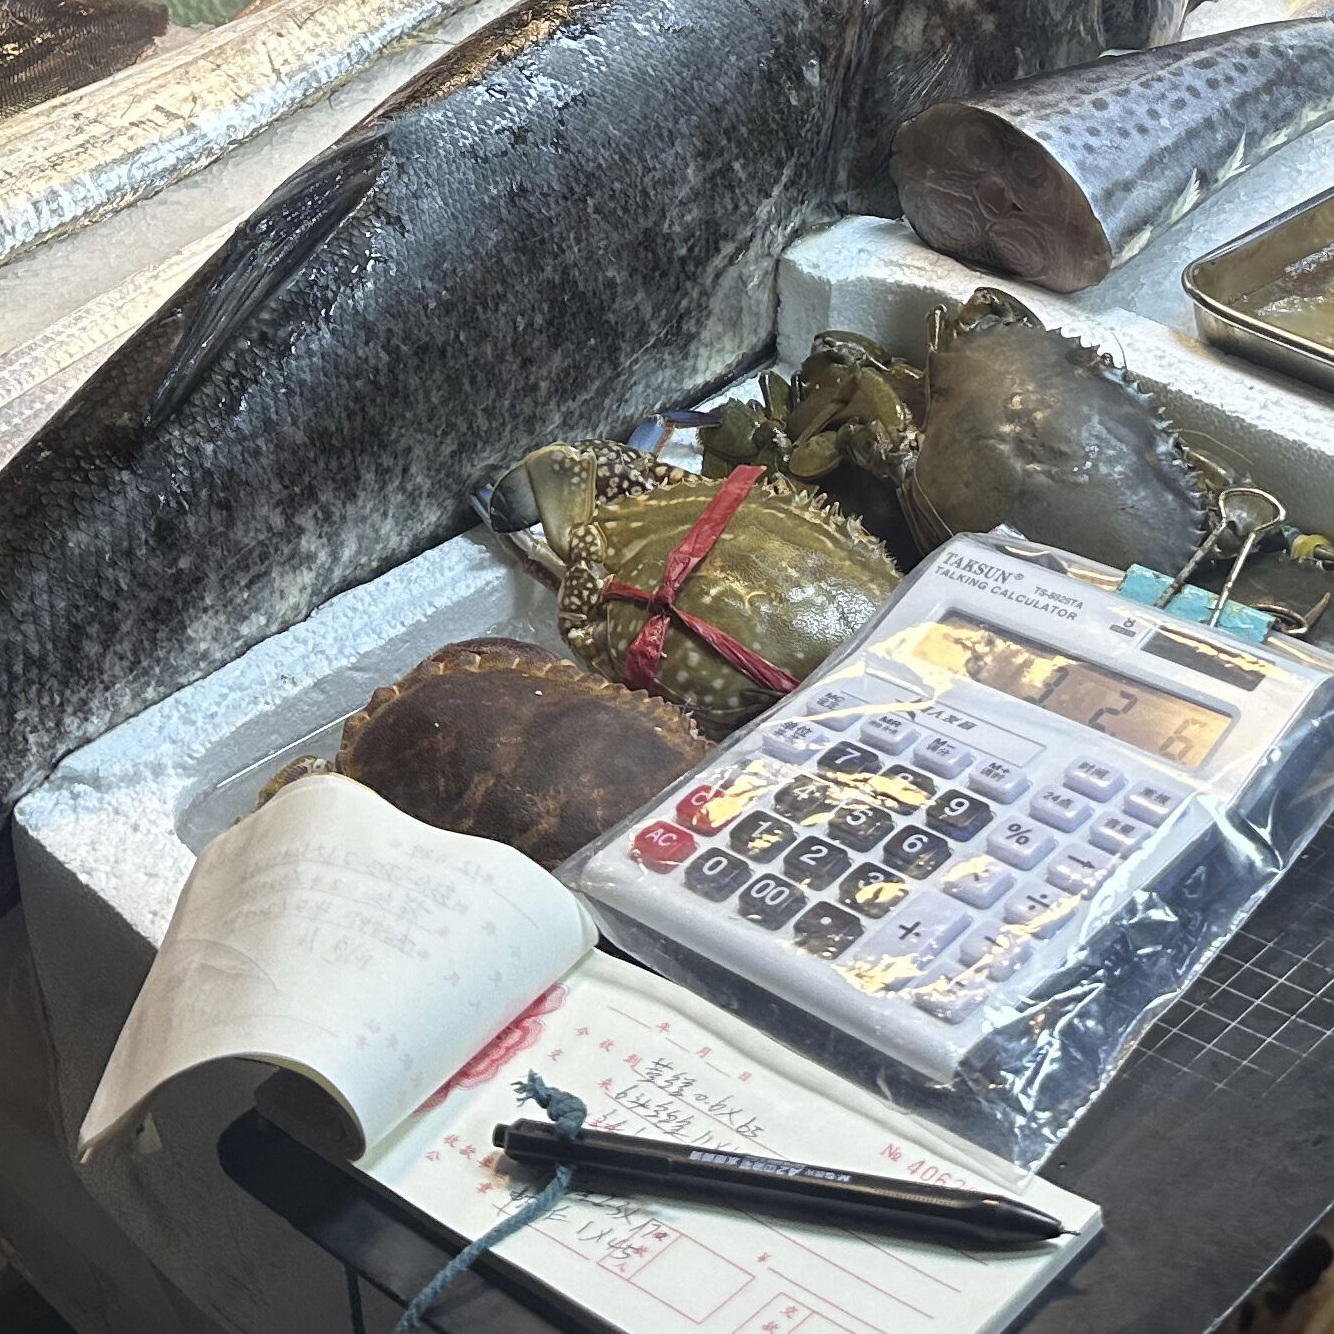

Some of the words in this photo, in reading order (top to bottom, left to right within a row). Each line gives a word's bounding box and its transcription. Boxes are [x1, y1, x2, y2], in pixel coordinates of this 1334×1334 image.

[943, 552, 1014, 585] TAKSUN
[935, 565, 989, 591] TALKING
[991, 585, 1079, 621] CALCULATOR
[834, 747, 862, 765] 7
[793, 785, 820, 801] 4
[846, 806, 874, 826] 5
[943, 797, 970, 817] 9
[645, 828, 678, 847] AC
[751, 820, 773, 839] 1
[902, 834, 929, 853] 6
[799, 845, 829, 866] 2
[702, 856, 728, 876] 0
[750, 879, 790, 906] 00
